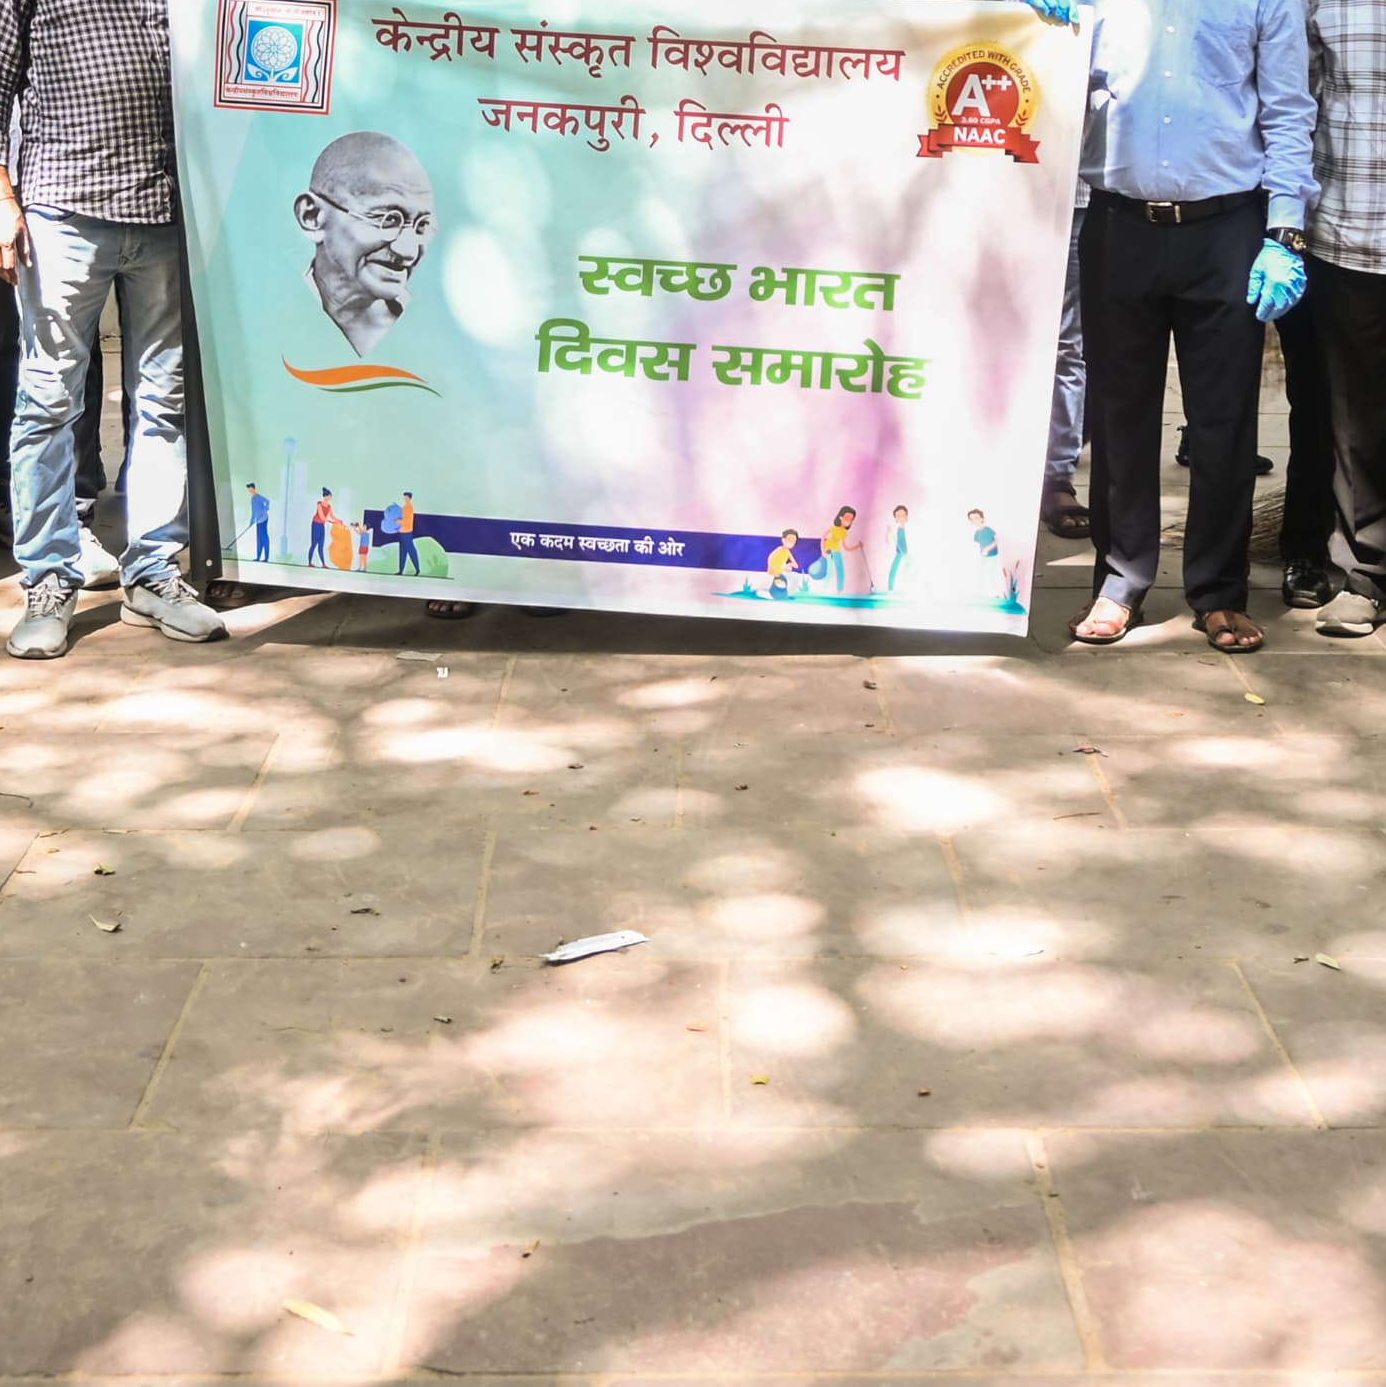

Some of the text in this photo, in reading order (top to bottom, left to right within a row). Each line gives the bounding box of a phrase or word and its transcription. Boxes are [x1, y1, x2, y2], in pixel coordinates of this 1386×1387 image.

[371, 7, 906, 82] केन्द्रीय संस्कृत विश्वविद्यालय
[937, 50, 1031, 93] ACCREDITED WITH GRADE
[951, 73, 1013, 117] A++
[673, 99, 790, 149] दिल्ली
[954, 126, 1006, 145] NAAC
[578, 255, 901, 311] स्वच्छ भारत
[534, 318, 932, 400] दिवस समारोह
[510, 532, 686, 557] एक कदम स्वच्छता की ओर
